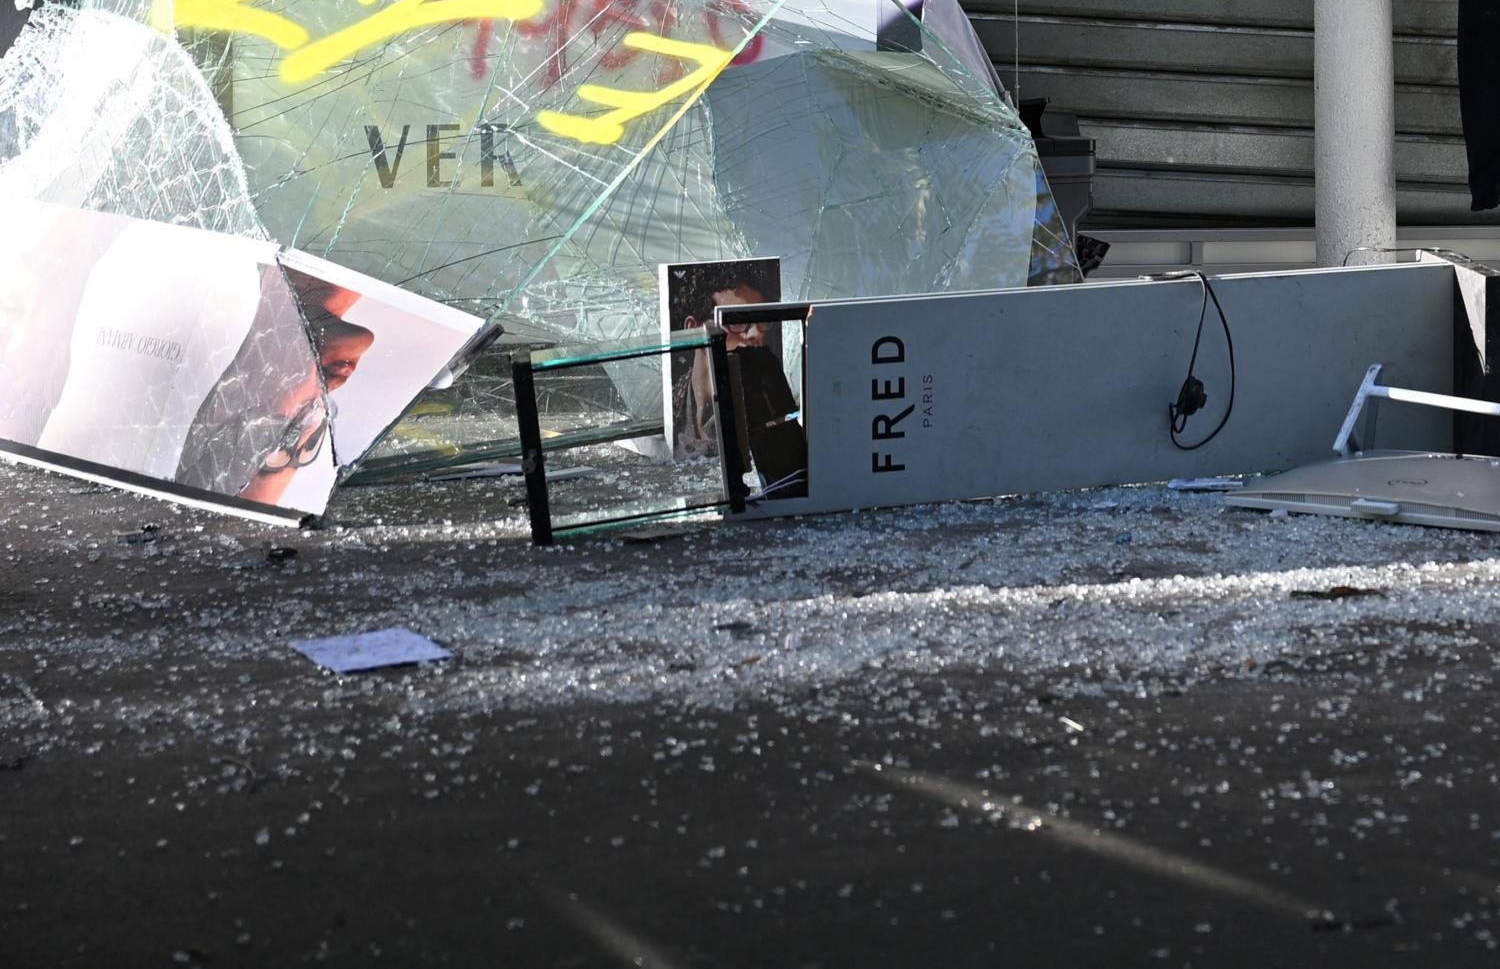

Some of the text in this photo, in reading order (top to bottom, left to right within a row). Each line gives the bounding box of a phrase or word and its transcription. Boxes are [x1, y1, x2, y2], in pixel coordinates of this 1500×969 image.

[137, 335, 182, 361] GIORGIO
[871, 335, 916, 473] FRED
[922, 374, 933, 428] PARIS
